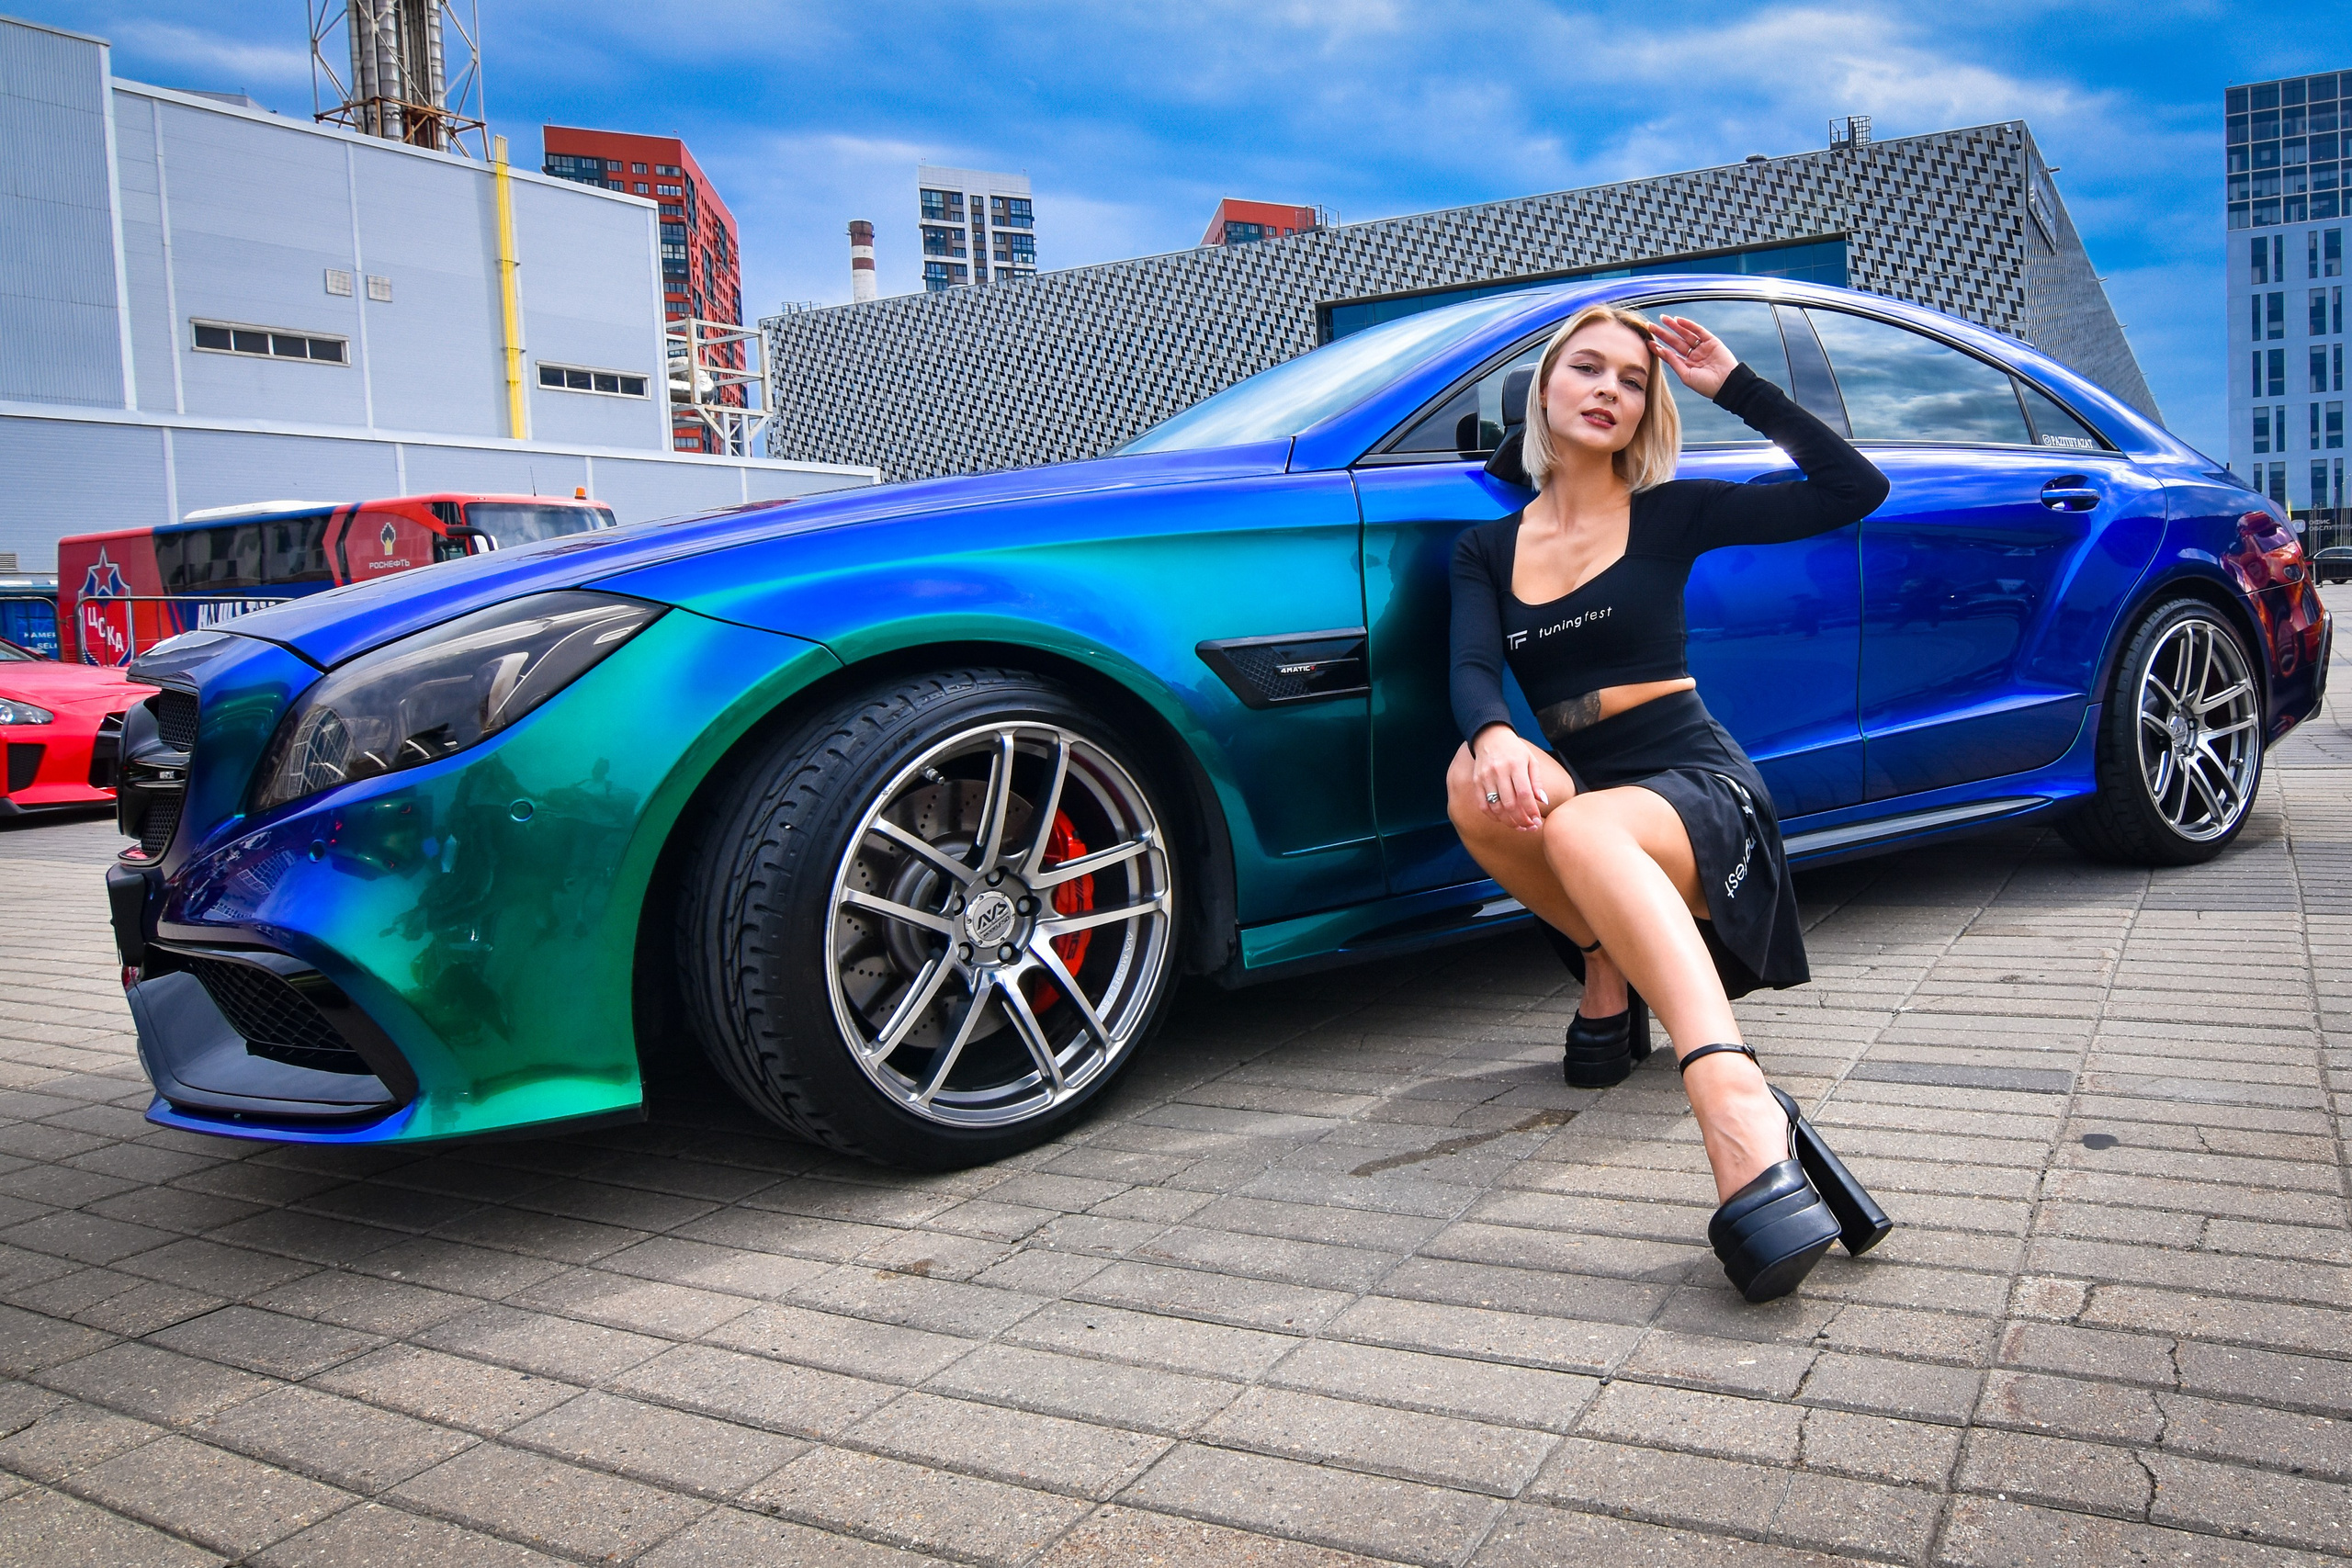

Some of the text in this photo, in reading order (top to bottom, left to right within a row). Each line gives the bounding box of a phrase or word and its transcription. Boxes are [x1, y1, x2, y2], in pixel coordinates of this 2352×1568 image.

[368, 558, 410, 570] РОСНЕФТЬ
[87, 606, 124, 652] ЦСКА
[1280, 665, 1311, 673] 4MATIC
[1110, 954, 1129, 990] MODEL
